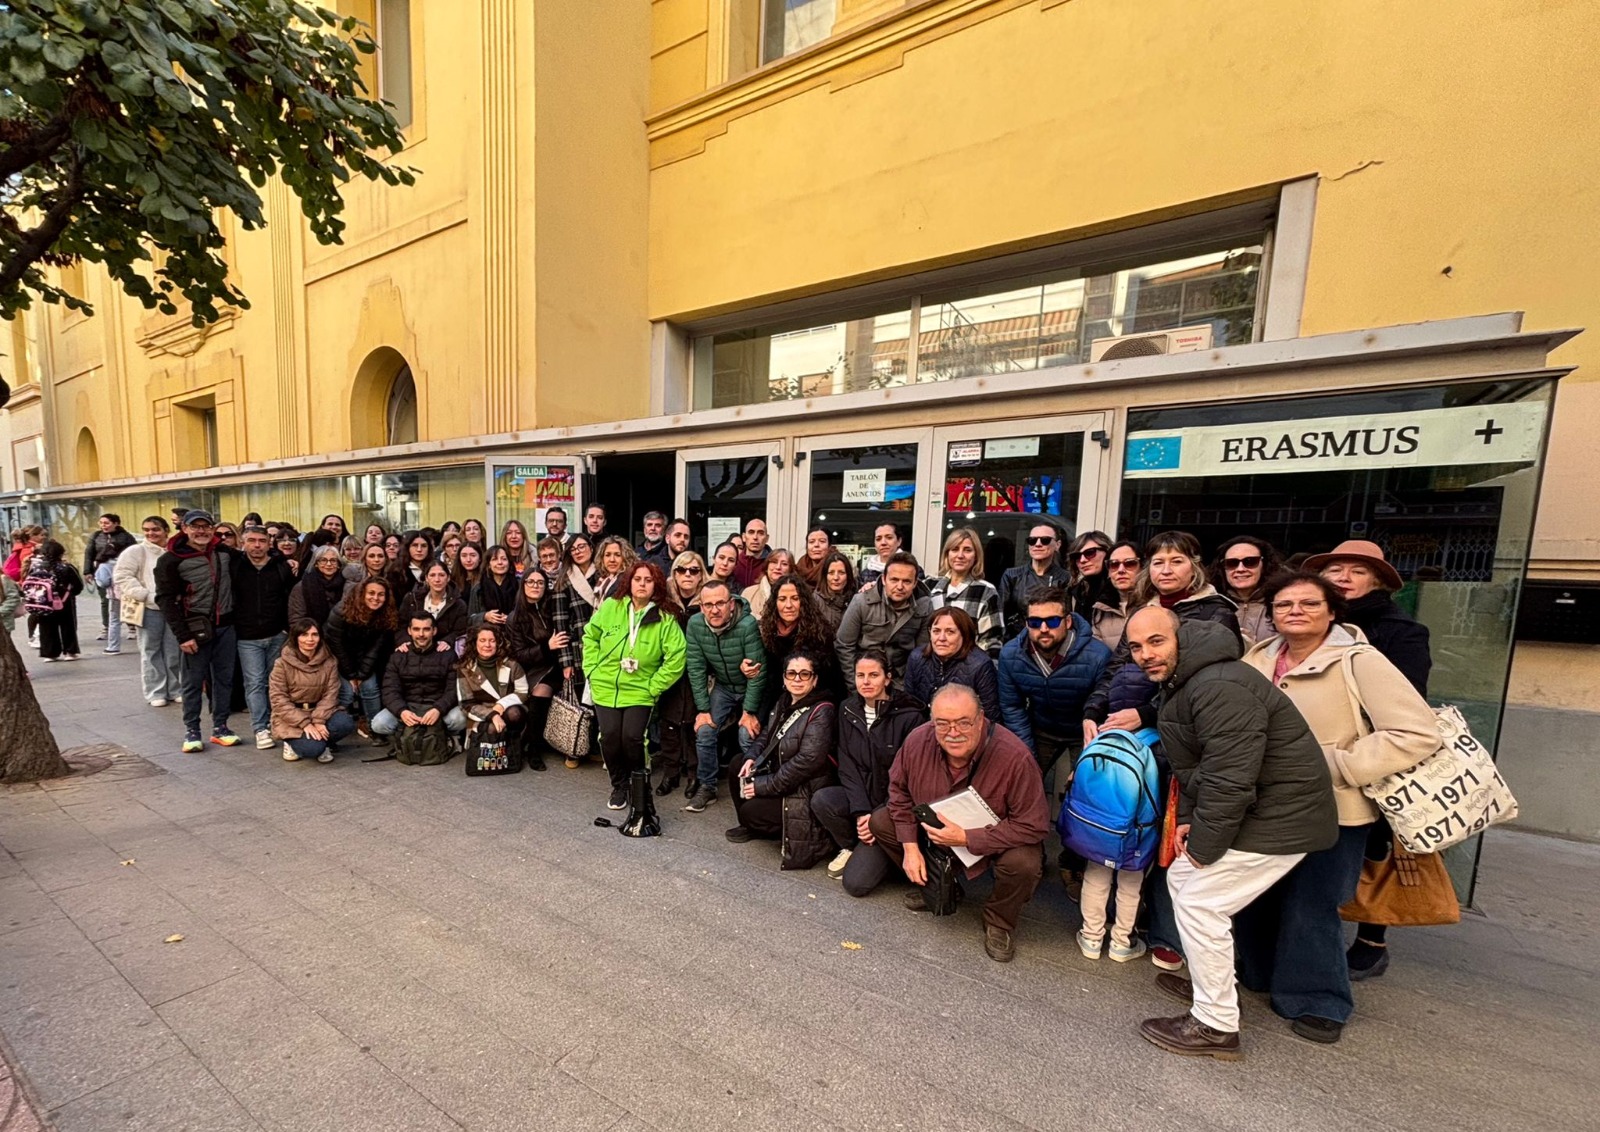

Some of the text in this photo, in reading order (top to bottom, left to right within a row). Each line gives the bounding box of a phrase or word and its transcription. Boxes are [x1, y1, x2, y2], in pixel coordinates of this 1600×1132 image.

[1176, 335, 1202, 344] TOSHIBA
[1220, 418, 1504, 463] ERASMUS +
[517, 468, 544, 476] SALIDA
[850, 473, 879, 481] TABLÓN
[1379, 779, 1428, 812] 971
[1432, 768, 1480, 812] 1971
[1414, 811, 1466, 849] 1971
[1465, 798, 1501, 836] 1971
